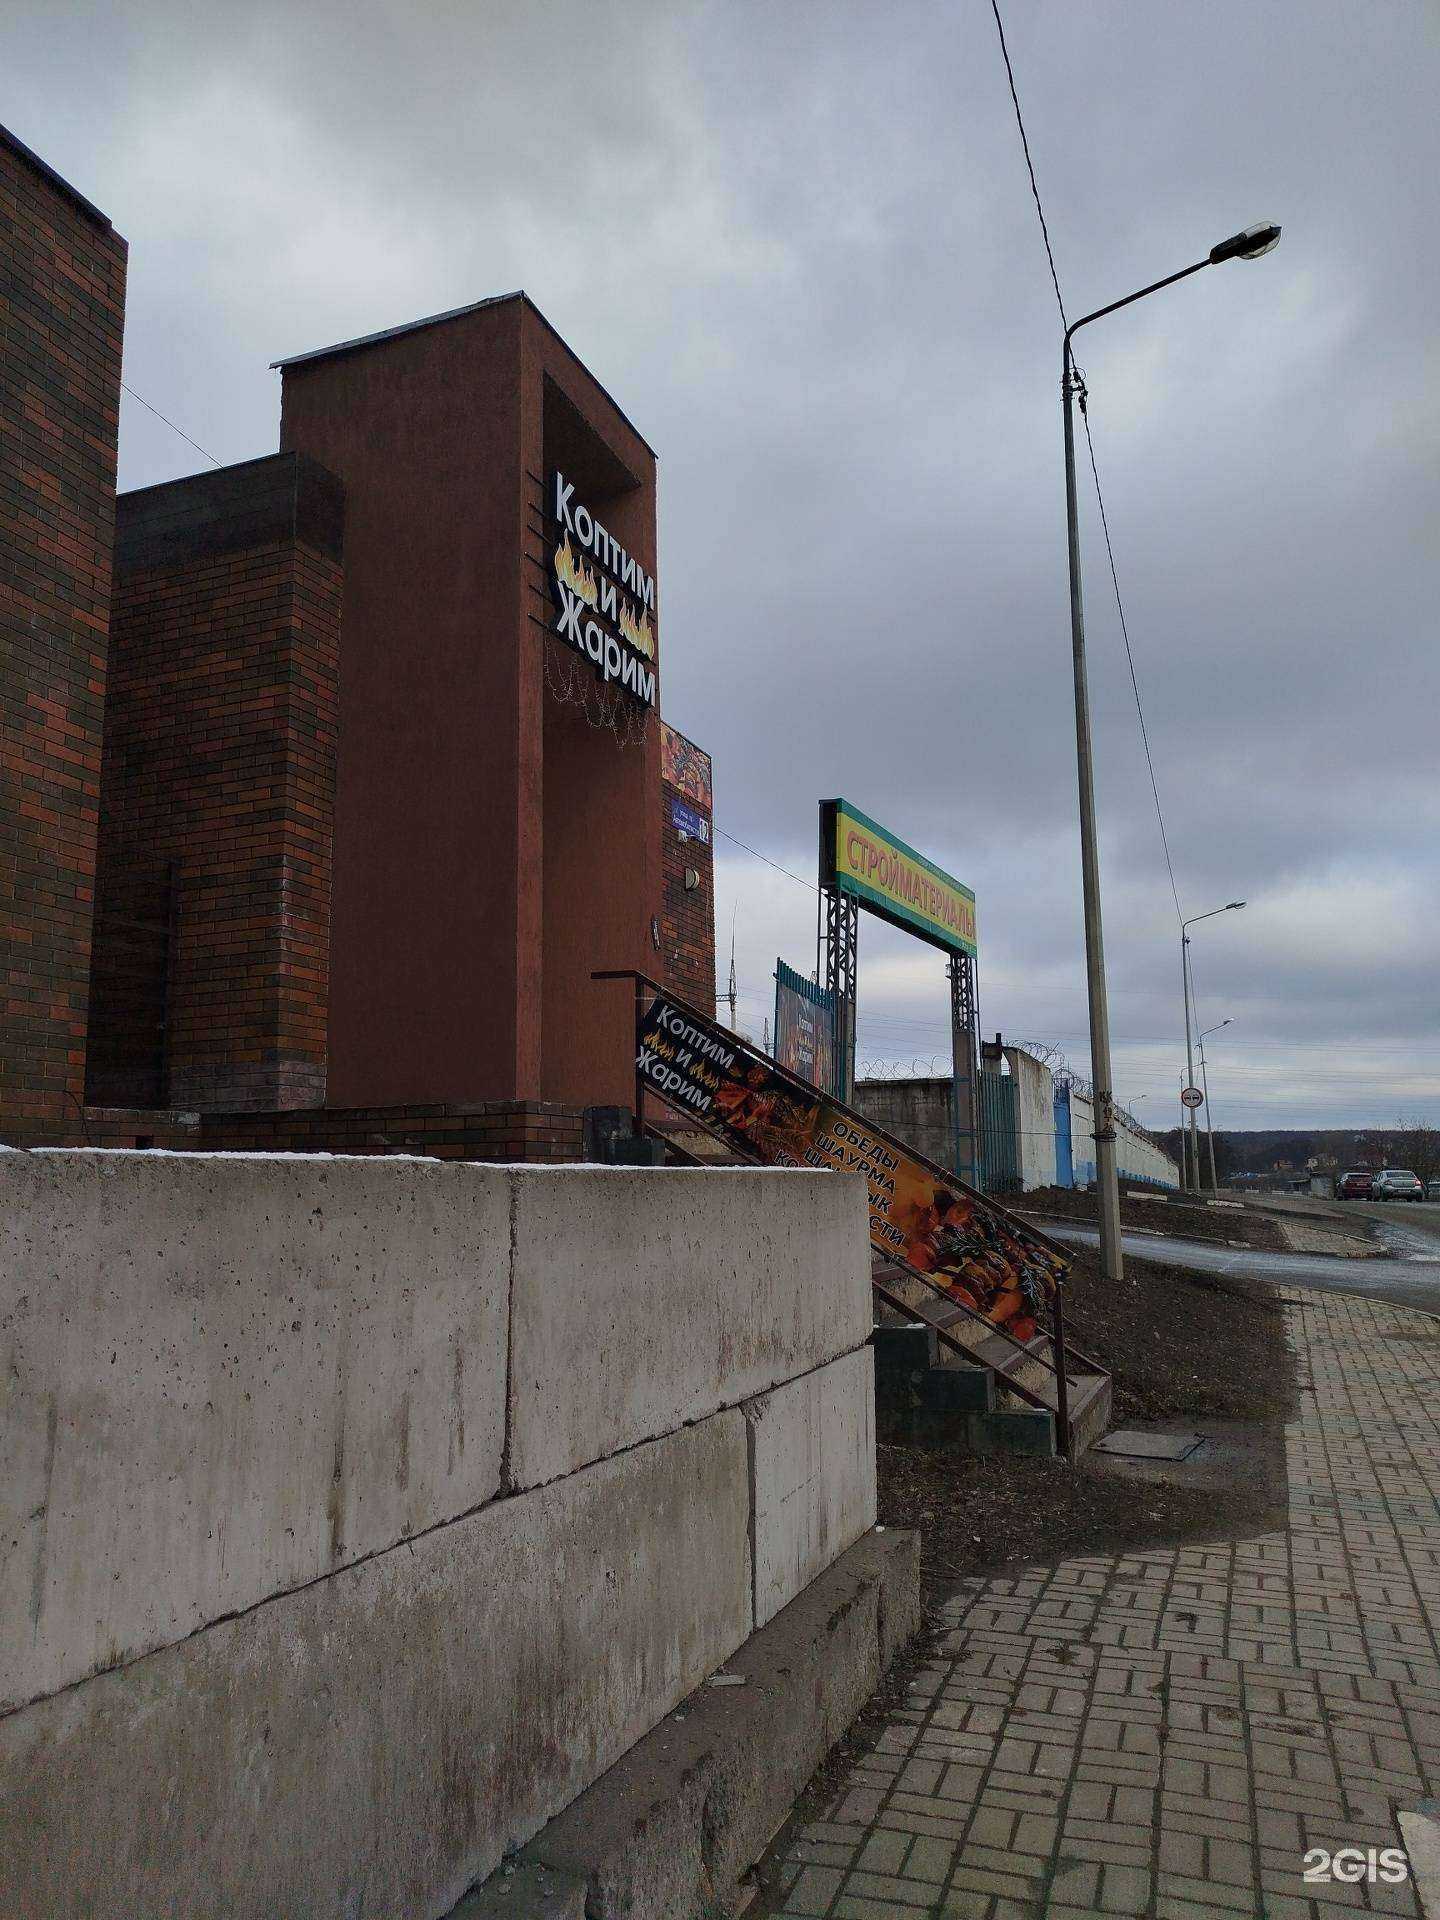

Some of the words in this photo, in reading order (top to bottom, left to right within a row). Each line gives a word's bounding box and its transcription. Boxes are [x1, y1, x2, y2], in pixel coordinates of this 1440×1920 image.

[556, 471, 654, 610] Коптим
[601, 576, 617, 622] и
[556, 580, 656, 707] Жарим
[846, 829, 976, 940] СТРОЙМАТЕРИАЛЫ
[656, 1004, 735, 1069] Коптим
[675, 1048, 693, 1068] и
[634, 1045, 713, 1112] Жарим
[815, 1131, 896, 1196] ШАУРМА
[832, 1121, 900, 1172] ОБЕДЫ
